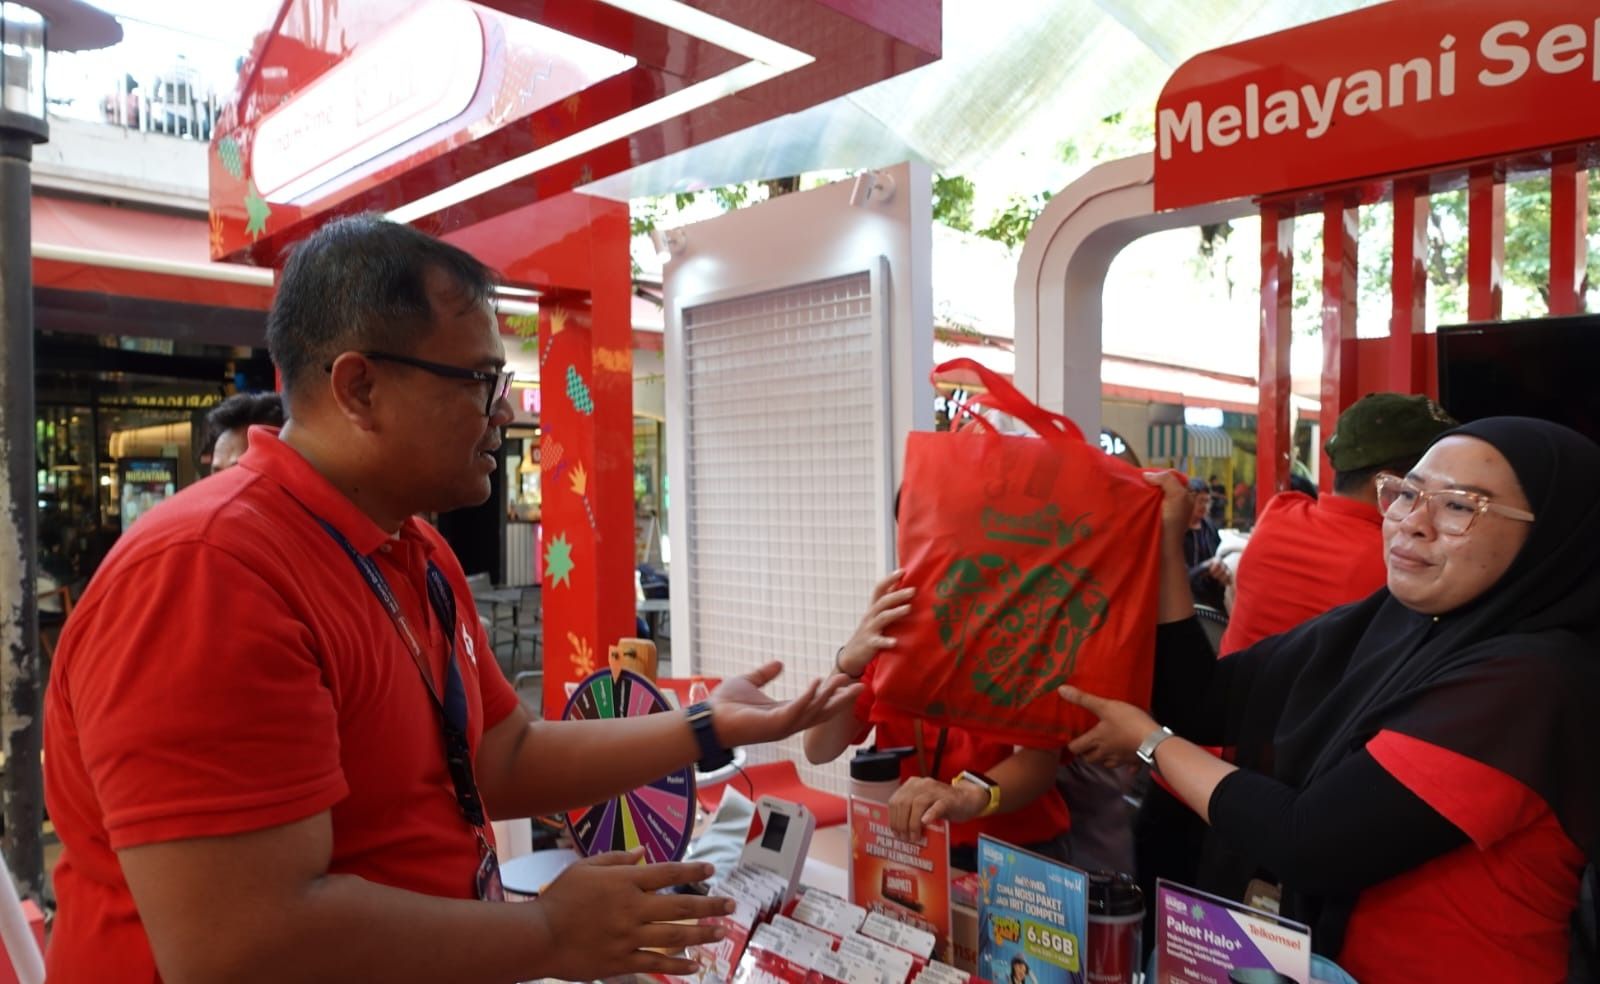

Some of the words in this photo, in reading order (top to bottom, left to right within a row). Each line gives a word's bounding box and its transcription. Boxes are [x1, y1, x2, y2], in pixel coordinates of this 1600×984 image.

[1159, 34, 1456, 160] Melayani
[1478, 20, 1600, 86] Se
[125, 471, 171, 482] NUSANTARA
[1036, 895, 1062, 912] PAKET
[1027, 925, 1074, 956] 6.5GB
[1167, 915, 1202, 940] Paket
[1249, 923, 1302, 950] Telkomsel
